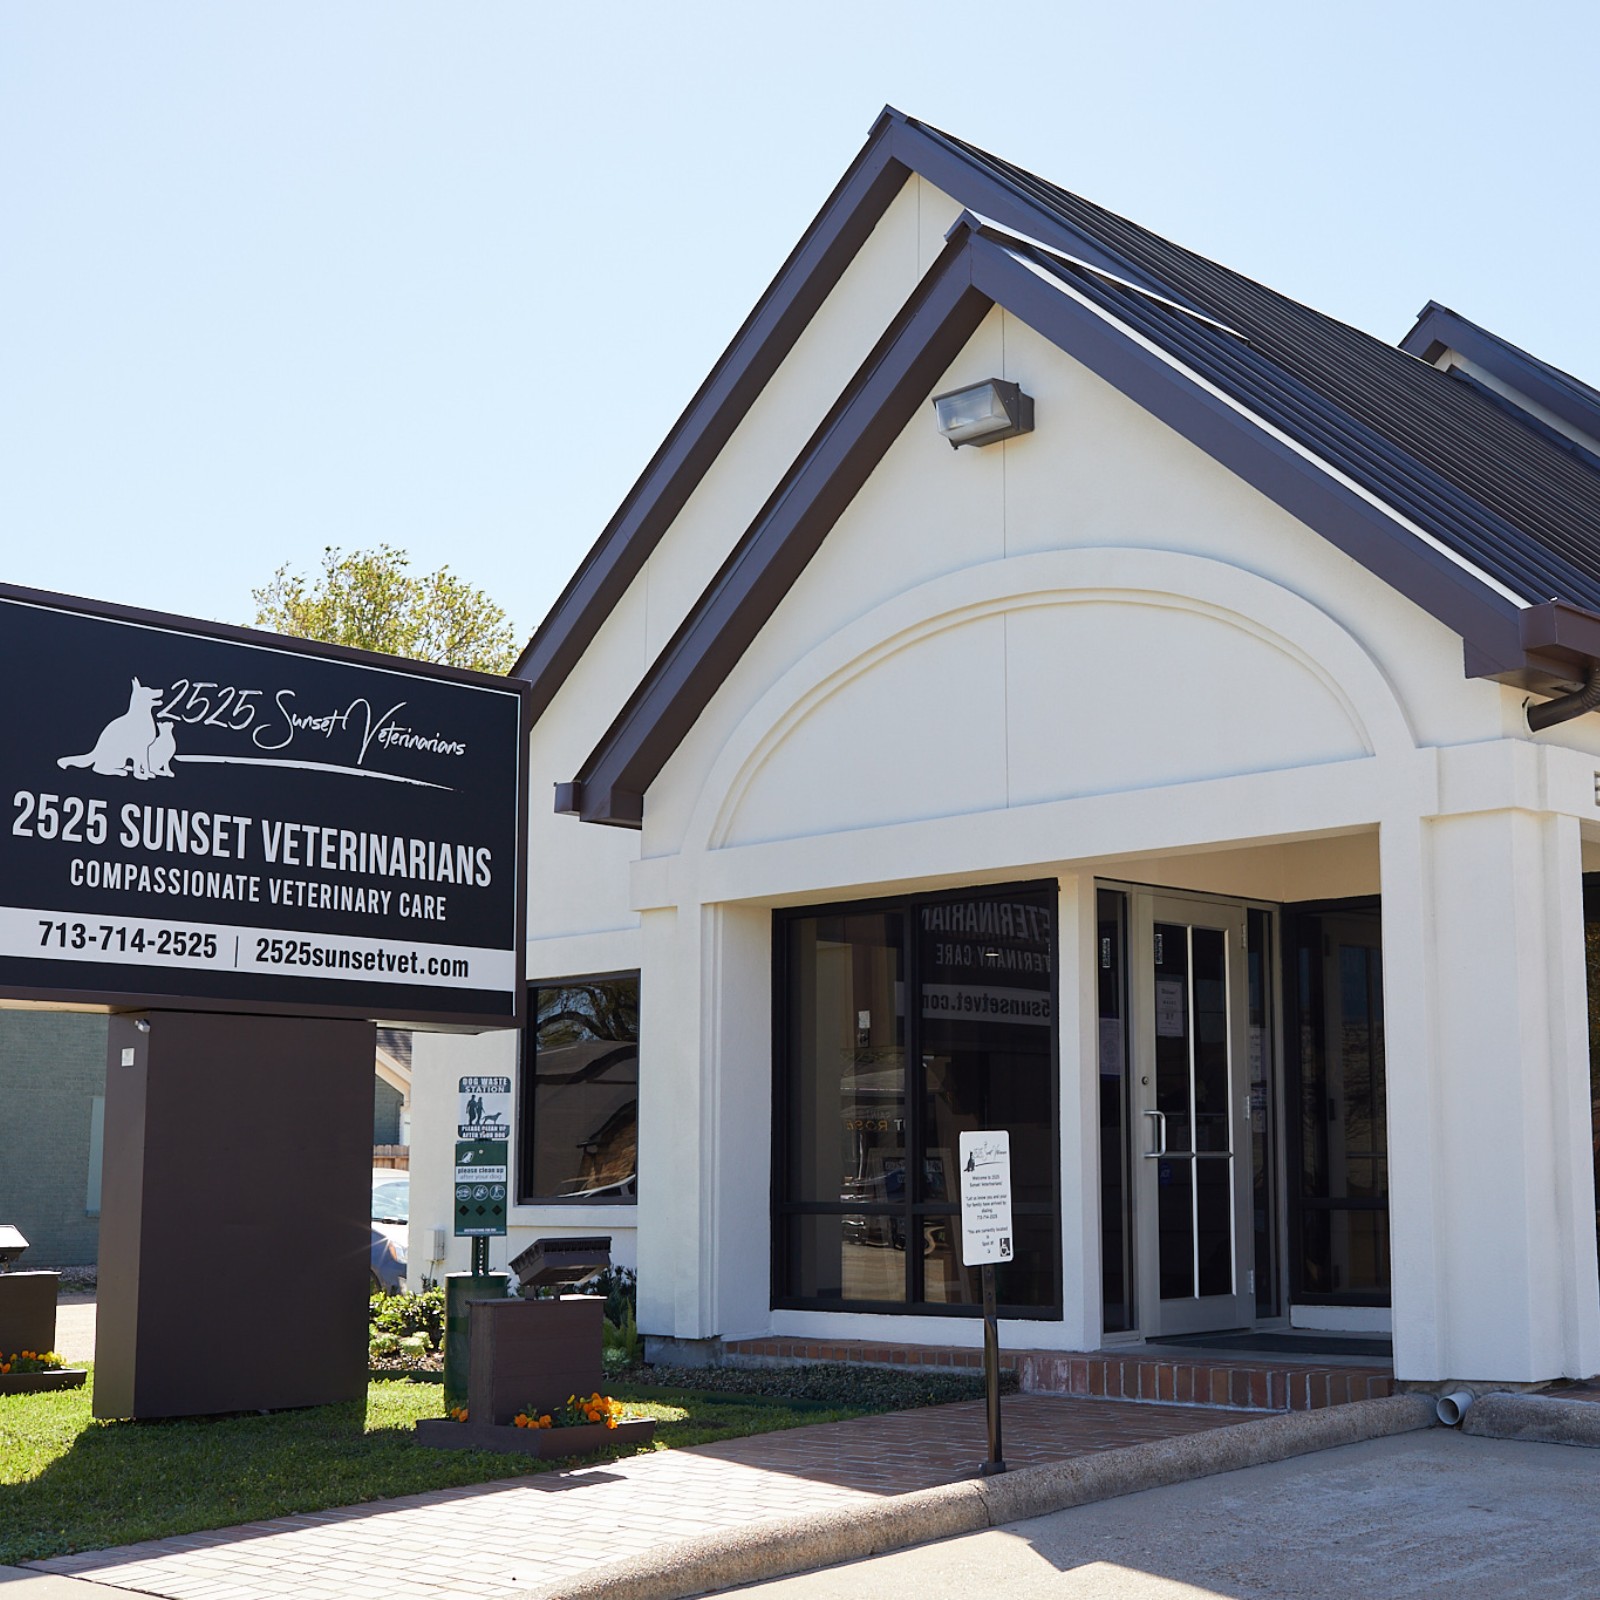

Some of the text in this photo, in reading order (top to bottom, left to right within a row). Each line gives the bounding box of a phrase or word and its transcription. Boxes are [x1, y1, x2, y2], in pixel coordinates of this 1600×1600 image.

[156, 678, 466, 765] 2525 Sunset Veterinarians
[12, 790, 492, 888] 2525 SUNSET VETERINARIANS
[70, 858, 447, 921] COMPASSIONATE VETERINARY CARE
[38, 920, 470, 978] 713-714-2525 2525sunsetvet.com
[462, 1077, 508, 1086] DOG WASTE
[464, 1085, 505, 1093] STATION
[496, 1167, 505, 1175] up
